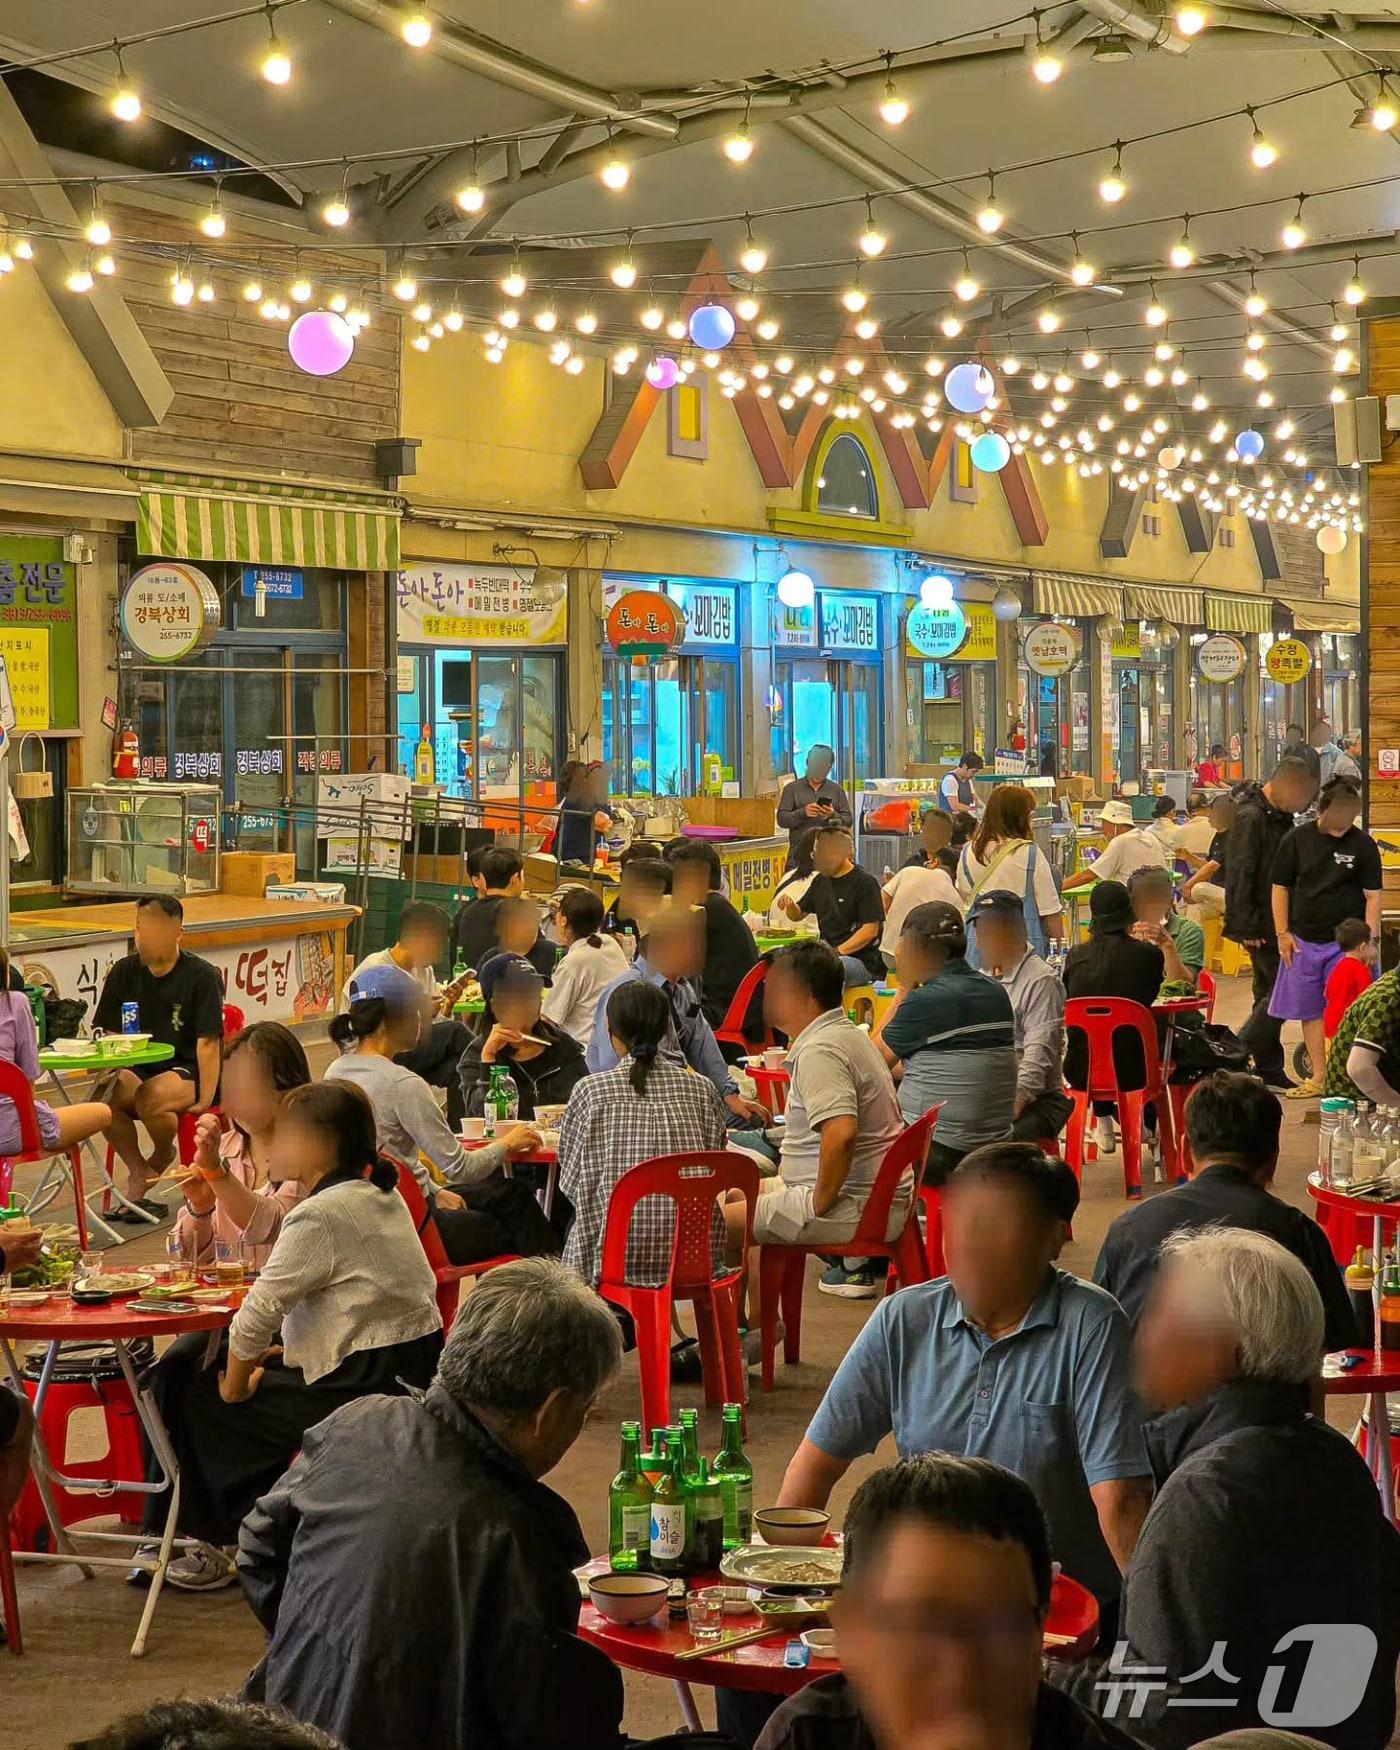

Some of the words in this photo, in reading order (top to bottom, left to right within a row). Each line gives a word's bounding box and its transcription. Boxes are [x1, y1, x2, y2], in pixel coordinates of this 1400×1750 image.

[138, 592, 154, 604] 의류
[157, 592, 186, 603] 도/소매
[134, 606, 190, 624] 경북상회
[159, 631, 193, 640] 255-6732
[1276, 645, 1298, 656] 수정
[174, 752, 222, 779] 경북상회
[236, 749, 283, 775] 경북상회
